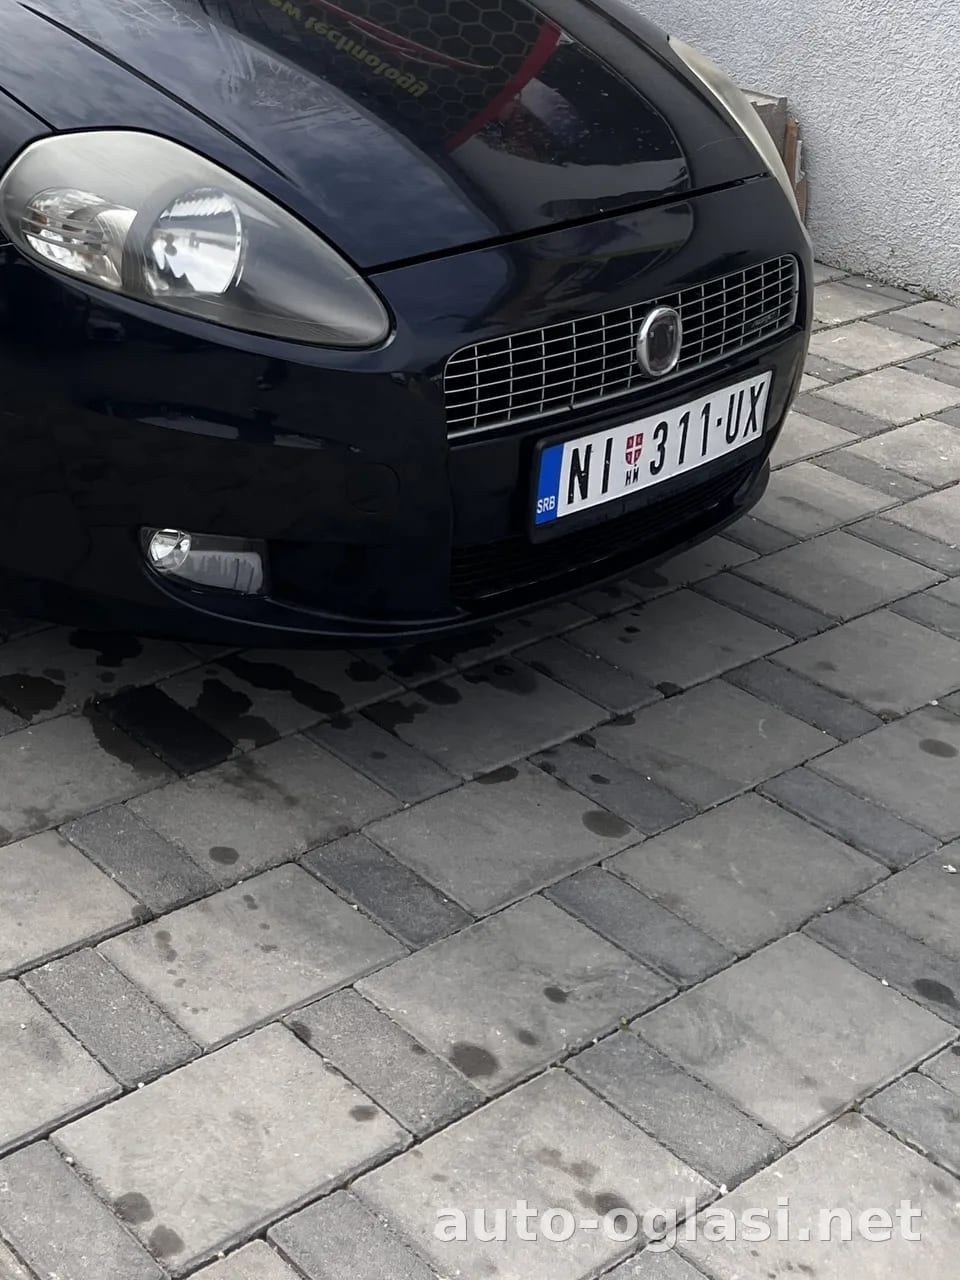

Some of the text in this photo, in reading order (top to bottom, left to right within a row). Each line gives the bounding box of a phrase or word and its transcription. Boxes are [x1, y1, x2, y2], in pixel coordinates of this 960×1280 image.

[649, 380, 766, 477] 311-UX
[536, 495, 556, 514] SRB
[566, 437, 614, 506] NI
